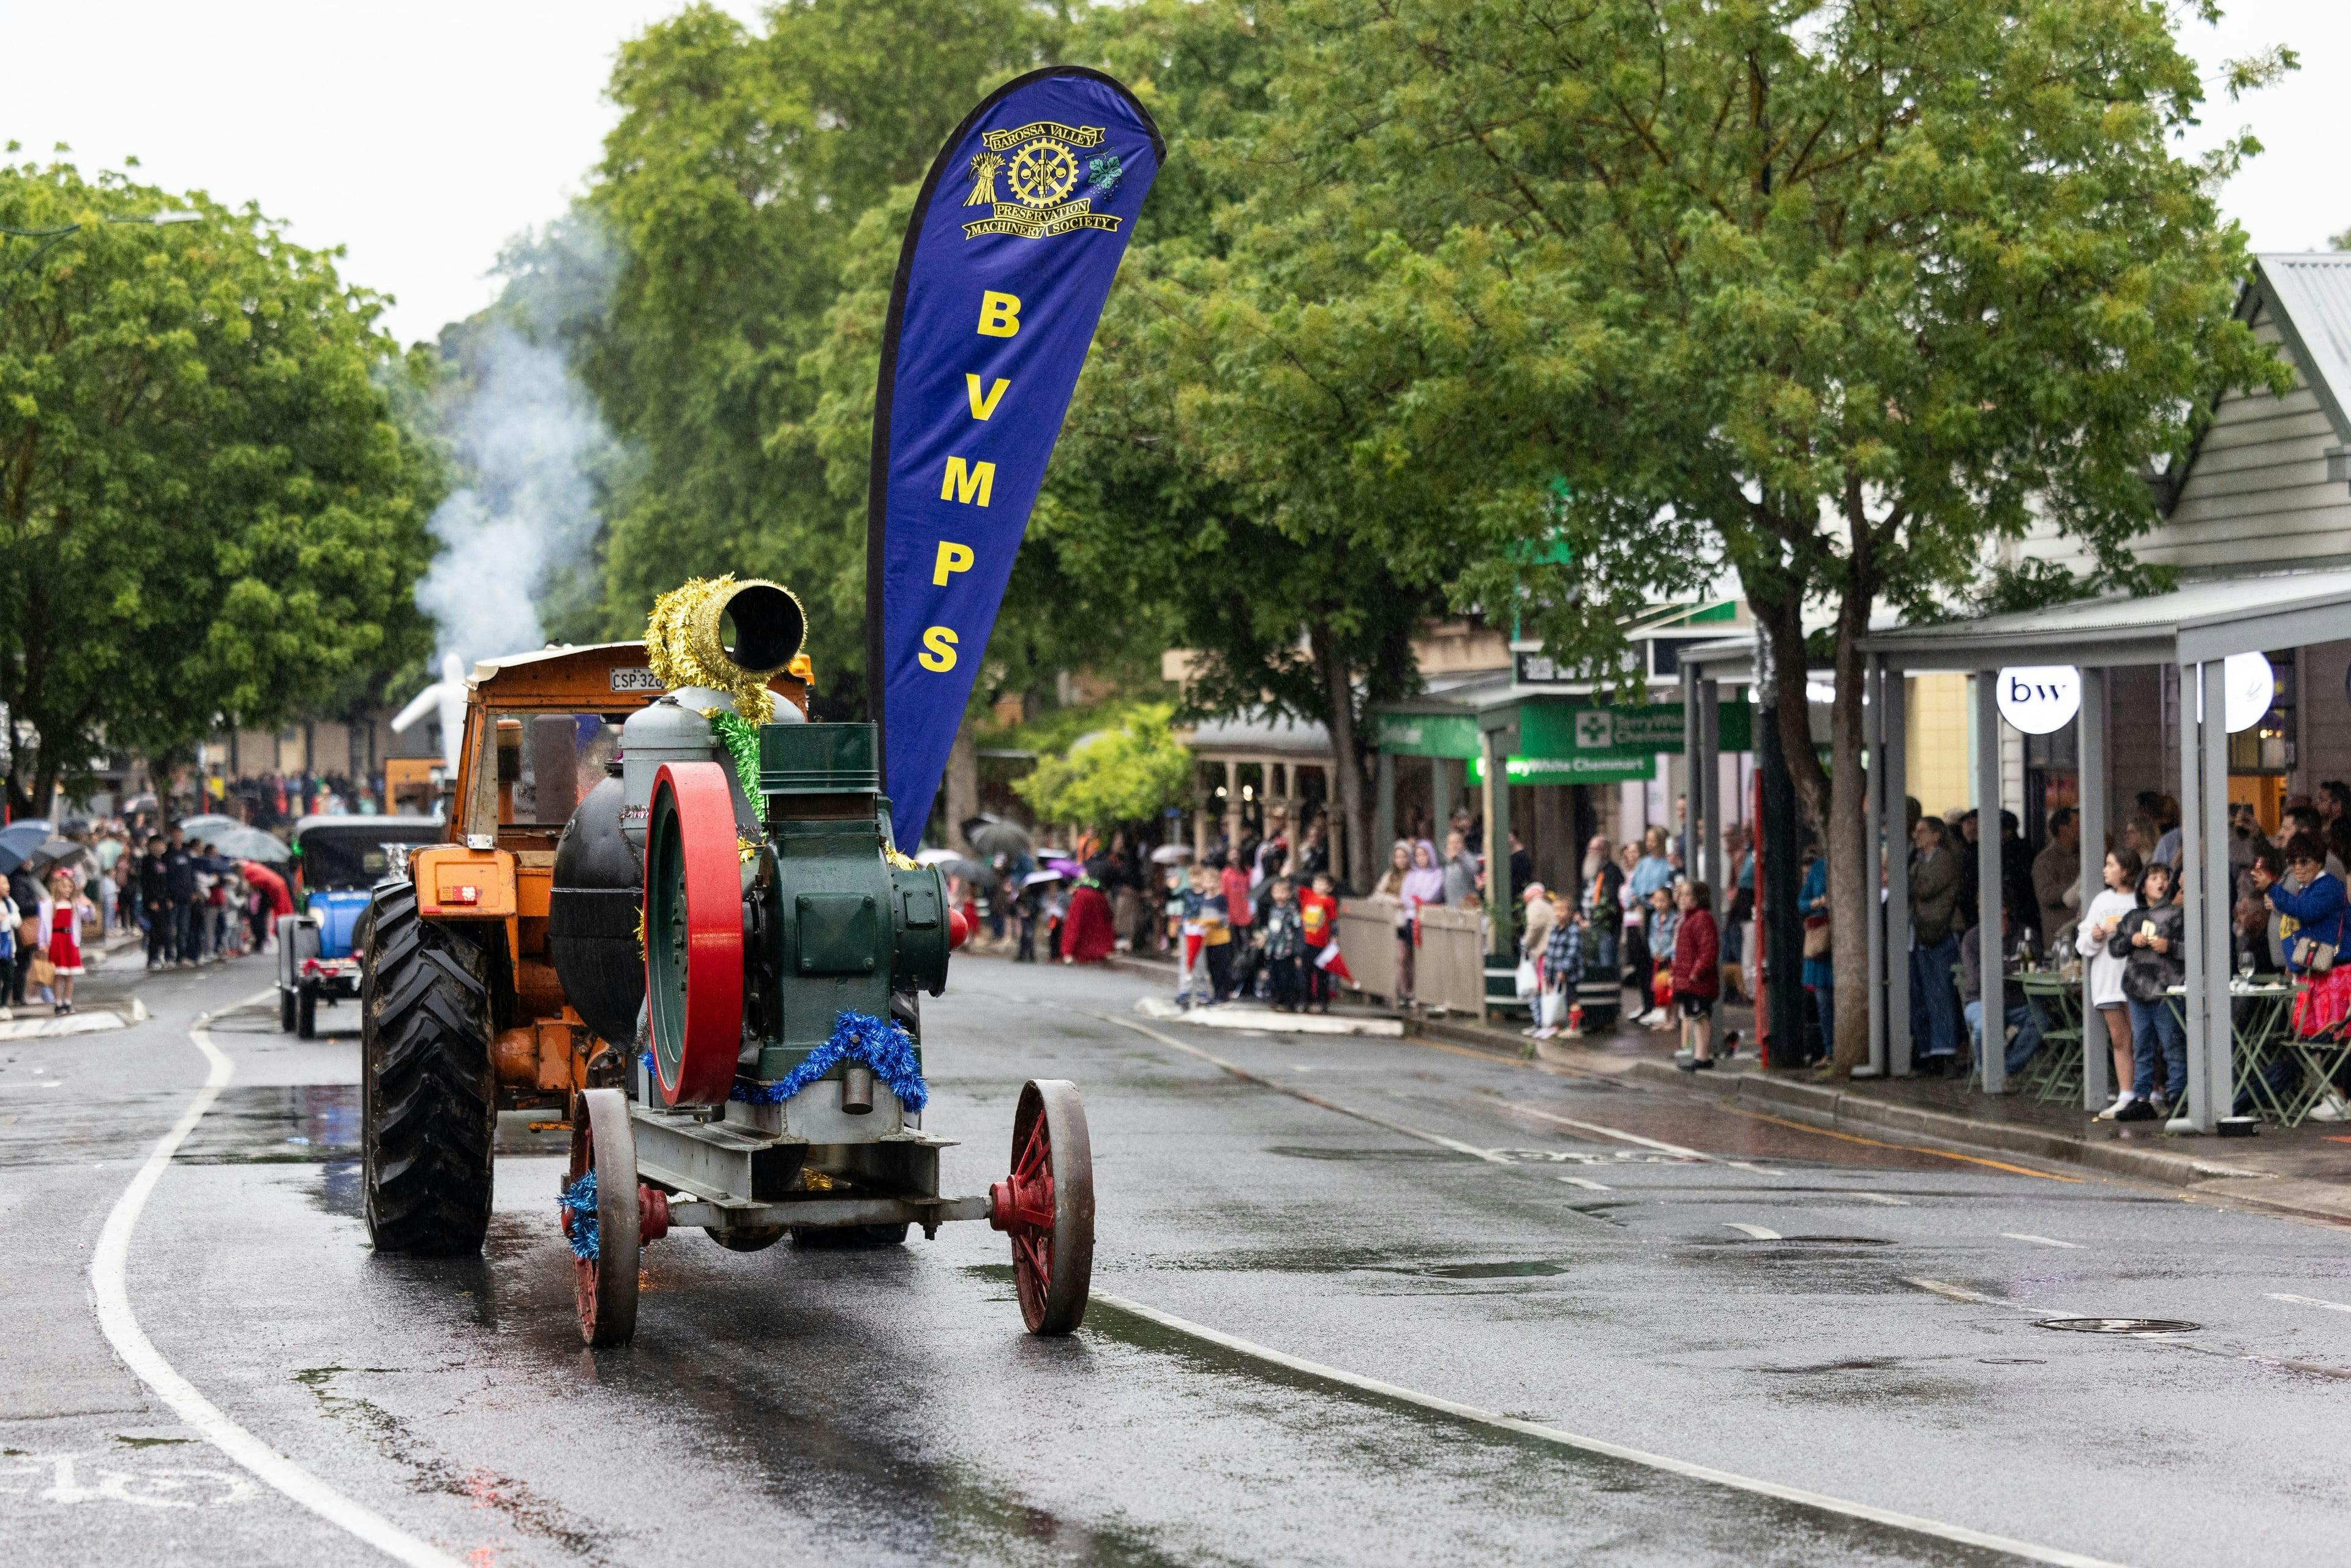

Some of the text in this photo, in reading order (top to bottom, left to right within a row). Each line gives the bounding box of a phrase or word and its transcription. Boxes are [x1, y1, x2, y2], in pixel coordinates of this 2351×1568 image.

[992, 124, 1094, 150] BAROSSA VALLEY
[997, 201, 1088, 222] PRESERVATION
[971, 217, 1111, 238] MACHINERY SOCIETY
[2011, 677, 2067, 702] bw
